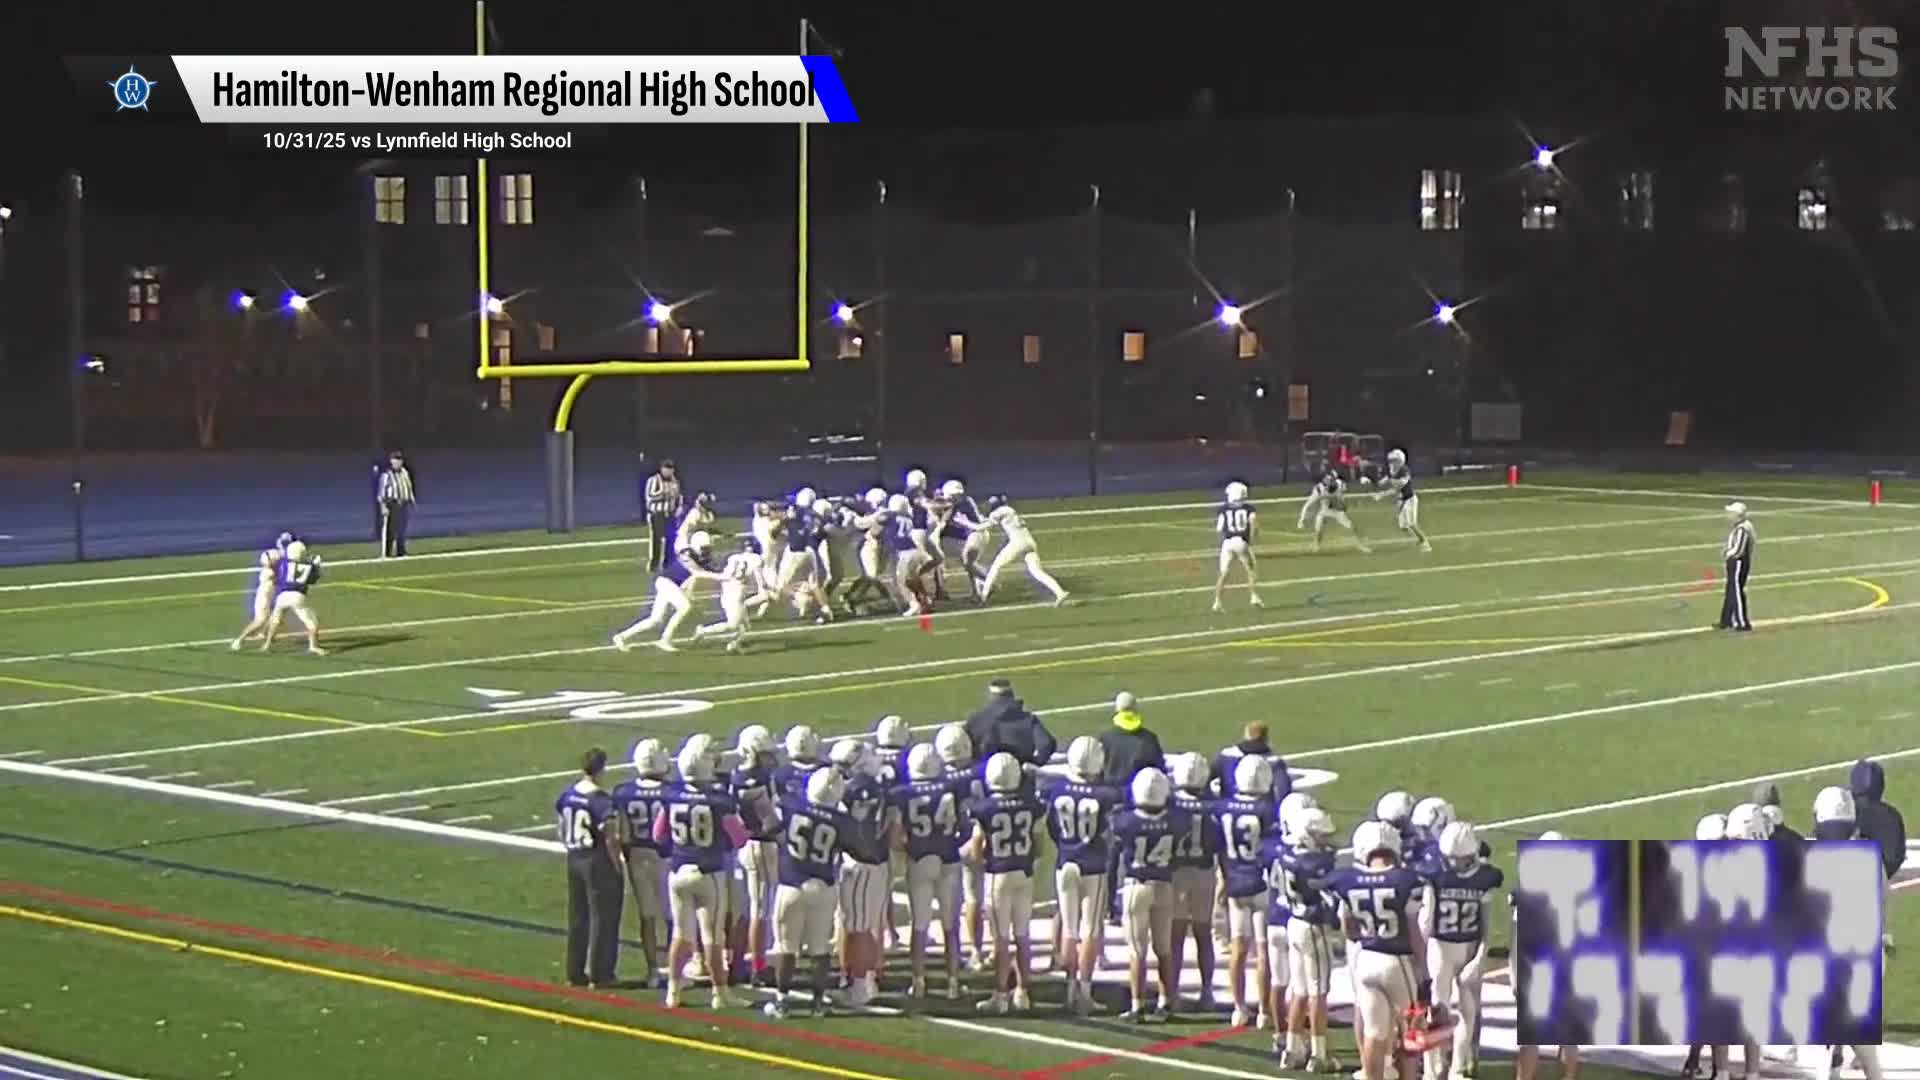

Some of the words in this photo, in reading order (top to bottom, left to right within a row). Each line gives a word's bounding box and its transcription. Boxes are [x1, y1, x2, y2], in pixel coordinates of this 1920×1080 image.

[1224, 508, 1248, 532] 10
[286, 561, 312, 582] 17
[908, 792, 957, 837] 54
[991, 811, 1032, 857] 23
[1222, 813, 1261, 860] 13
[787, 813, 837, 864] 59
[1131, 834, 1174, 868] 14
[1348, 887, 1400, 939] 55
[1439, 901, 1480, 933] 22
